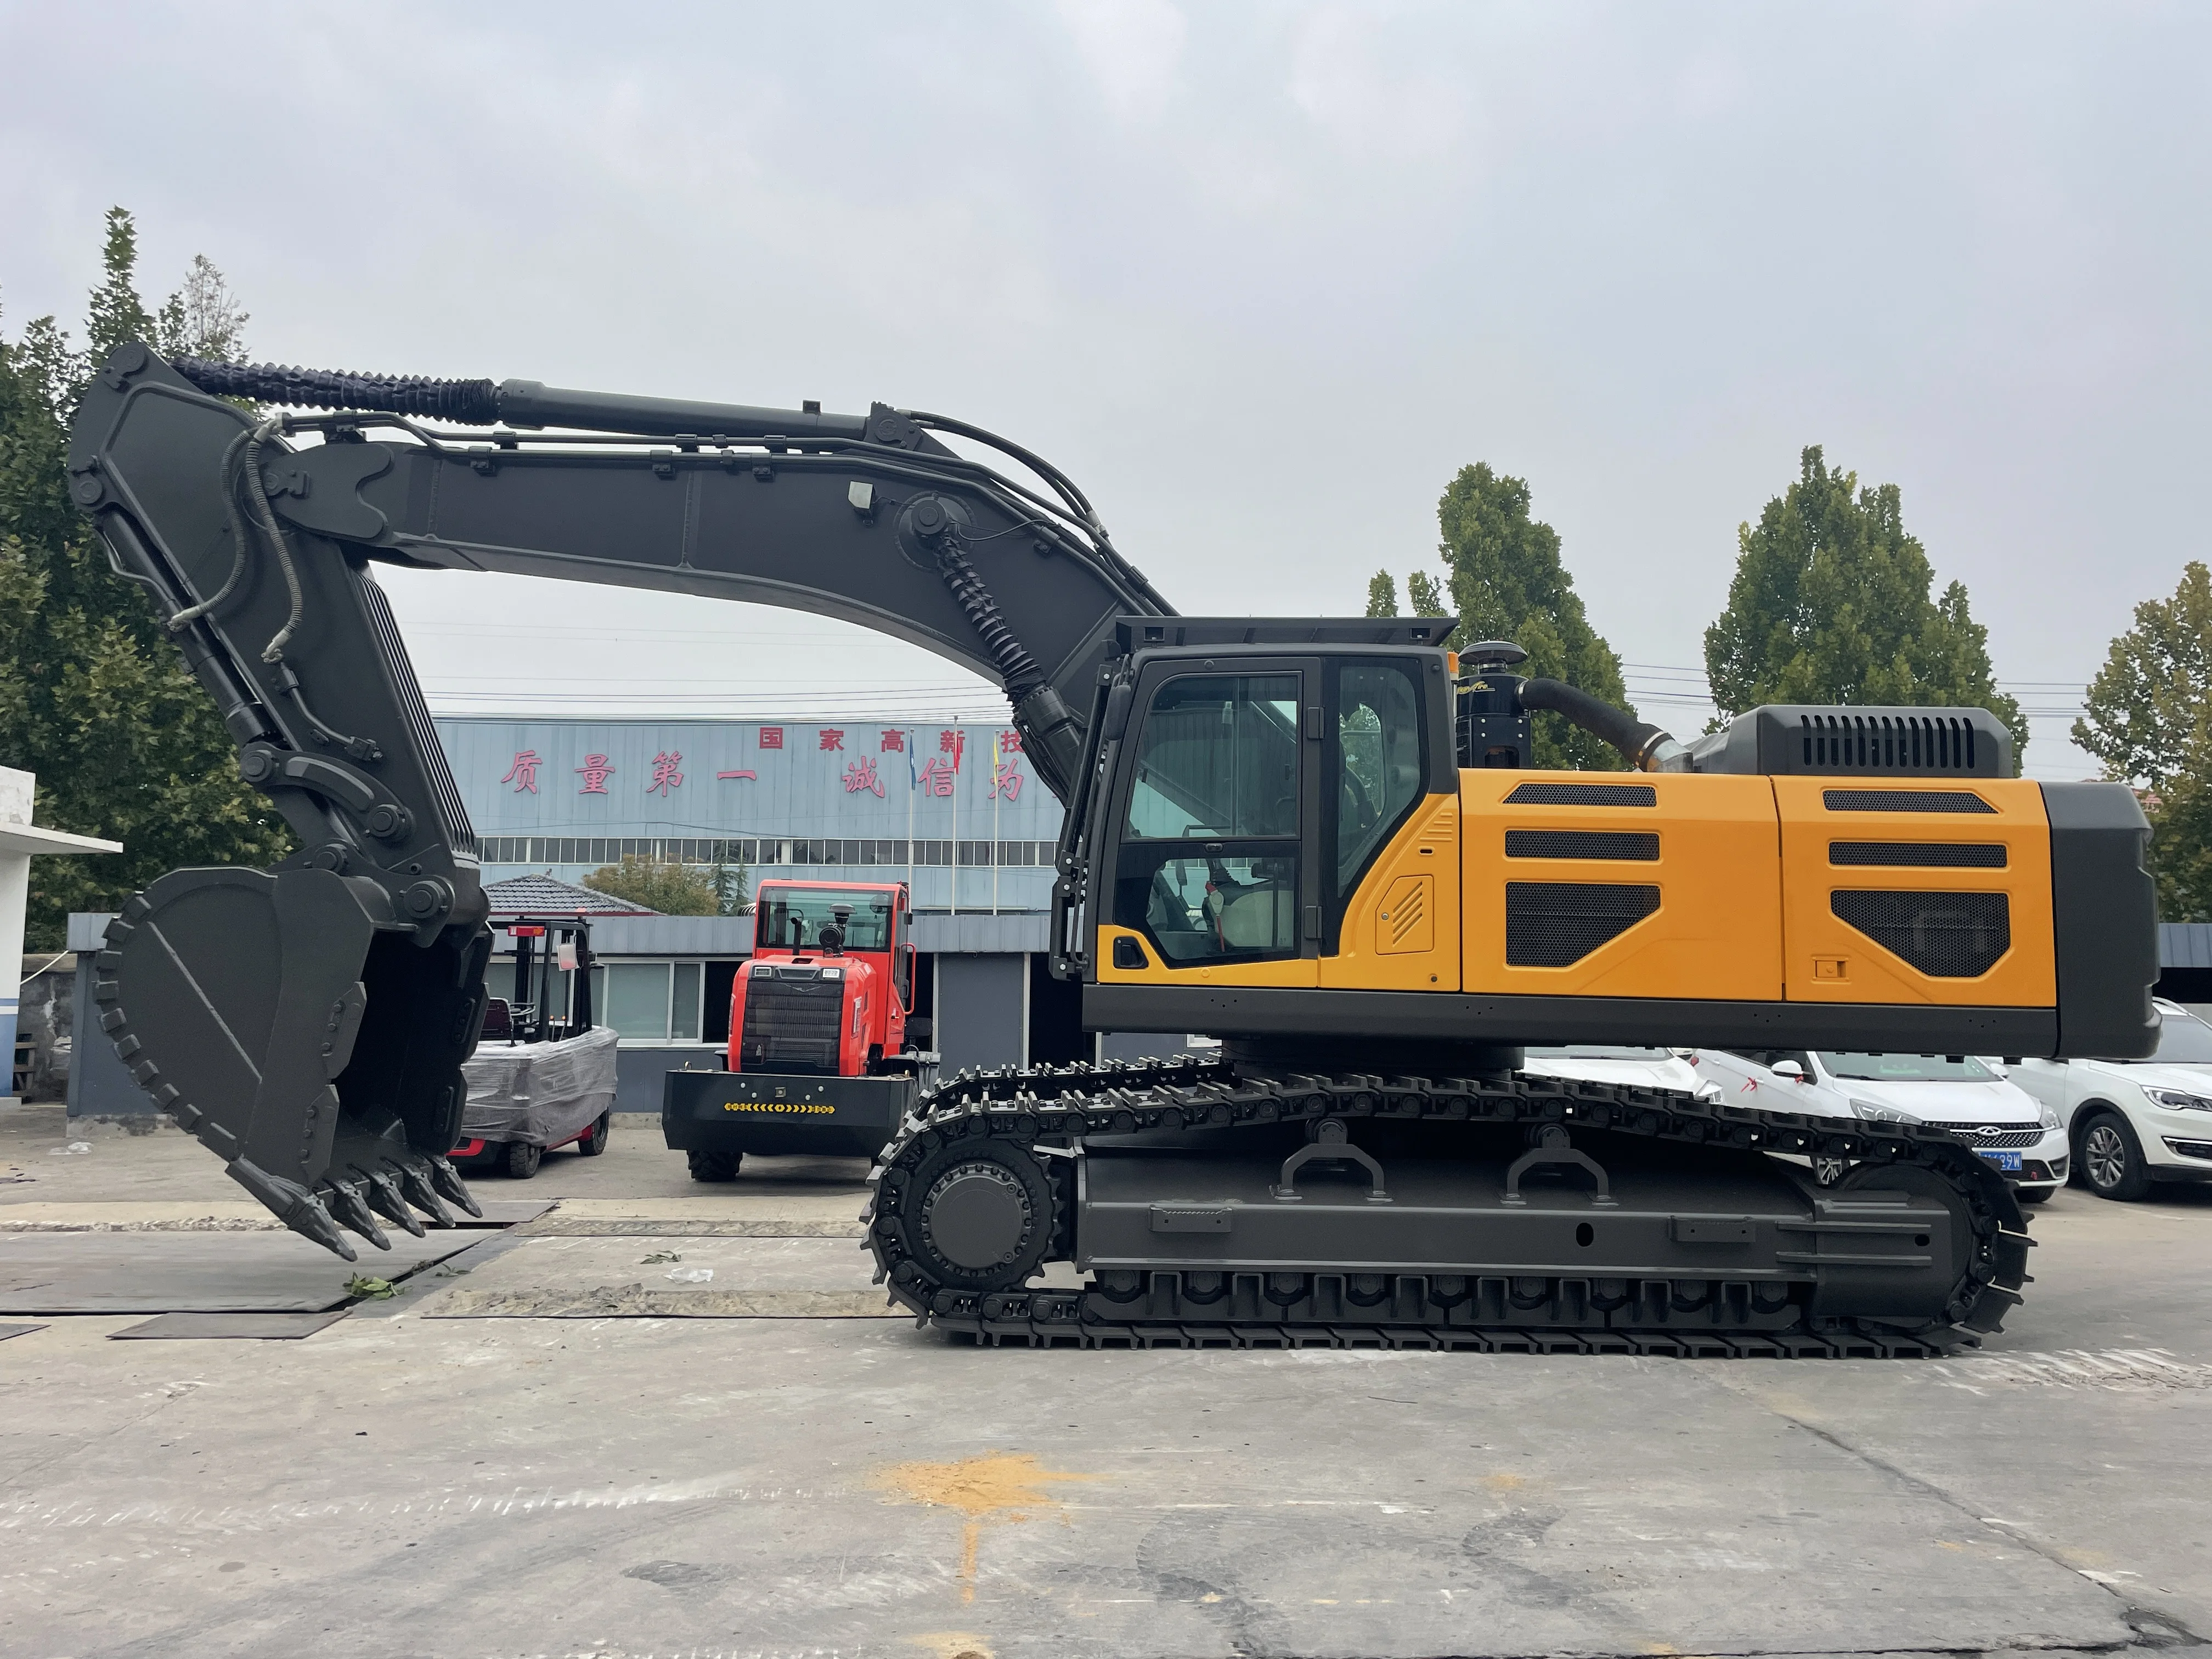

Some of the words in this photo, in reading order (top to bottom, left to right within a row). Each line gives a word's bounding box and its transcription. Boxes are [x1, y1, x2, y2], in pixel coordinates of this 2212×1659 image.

[759, 727, 1024, 753] 国家高新技
[500, 750, 757, 797] 质量第一
[843, 755, 1058, 801] 诚信为
